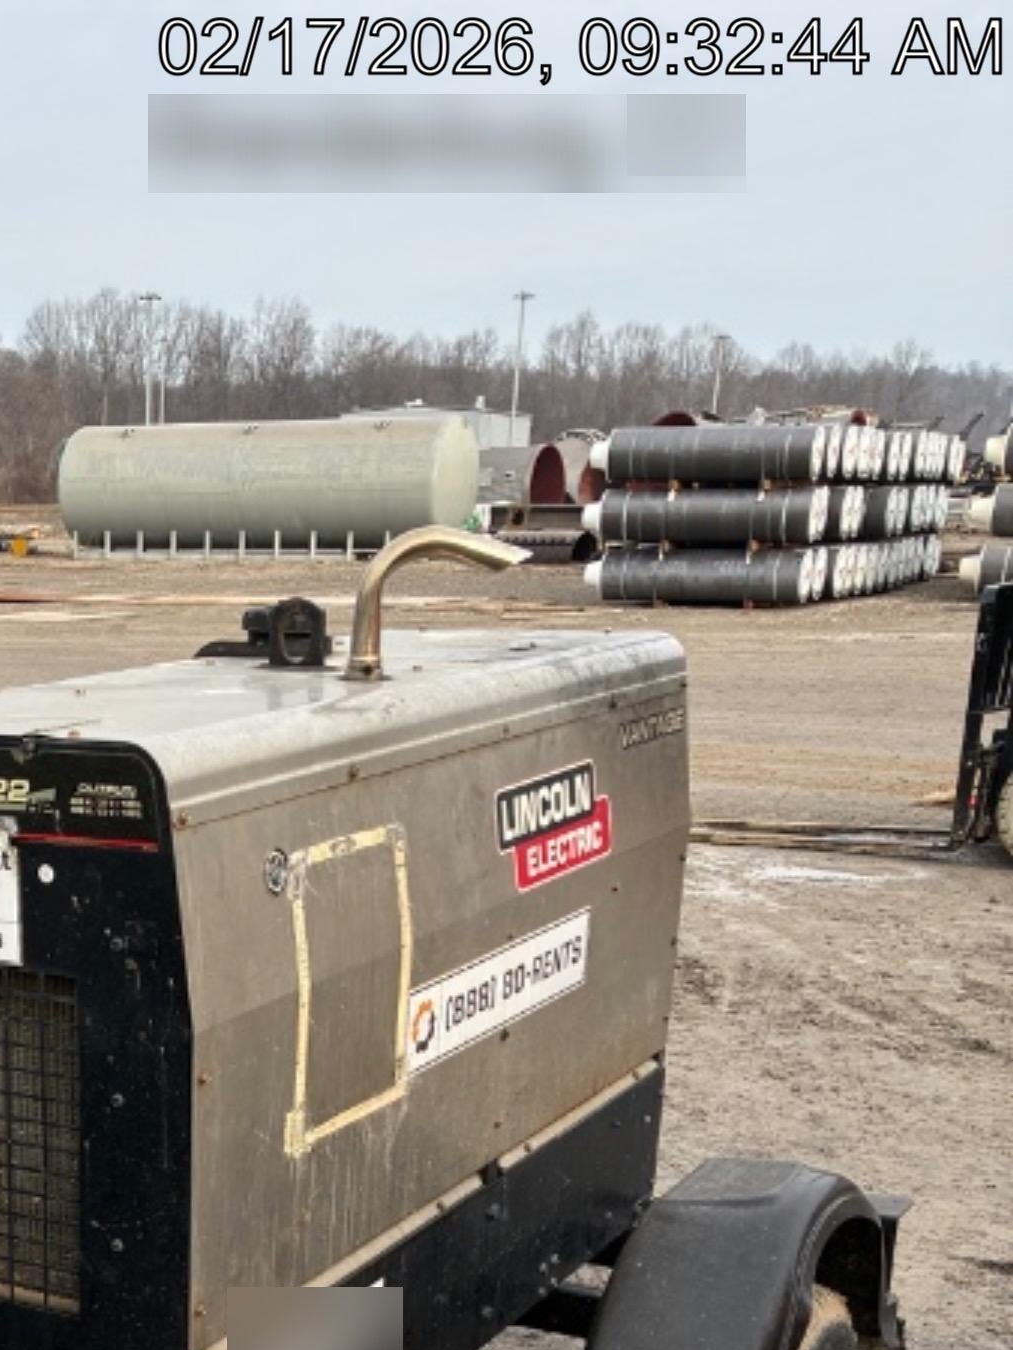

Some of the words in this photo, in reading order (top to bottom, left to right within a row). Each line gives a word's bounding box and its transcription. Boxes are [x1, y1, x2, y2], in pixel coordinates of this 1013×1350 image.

[499, 770, 593, 842] LINCOLN
[526, 819, 604, 879] ELECTRIC
[445, 974, 498, 1033] (888)
[502, 934, 583, 1001] 80-RENTS
